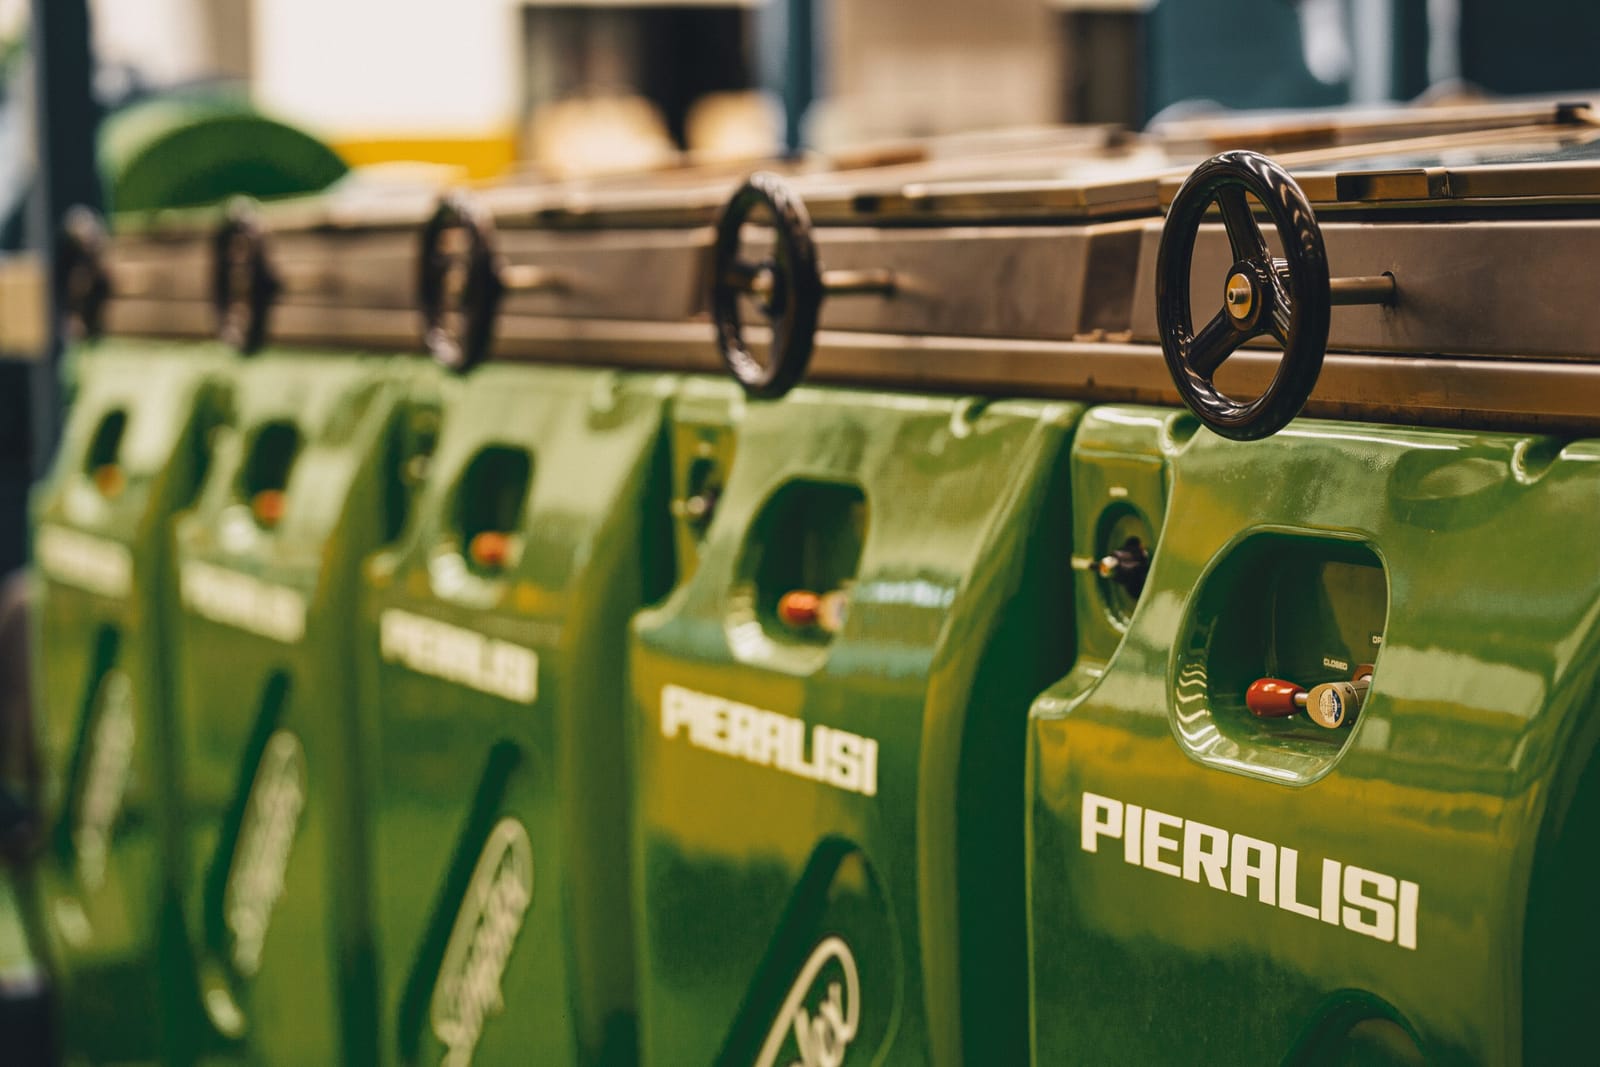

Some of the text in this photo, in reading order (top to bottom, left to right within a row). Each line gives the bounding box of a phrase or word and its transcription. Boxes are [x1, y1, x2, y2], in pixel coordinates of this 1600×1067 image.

[1323, 657, 1348, 671] CLOSED
[660, 684, 879, 797] PIERALISI
[1081, 791, 1419, 950] PIERALISI
